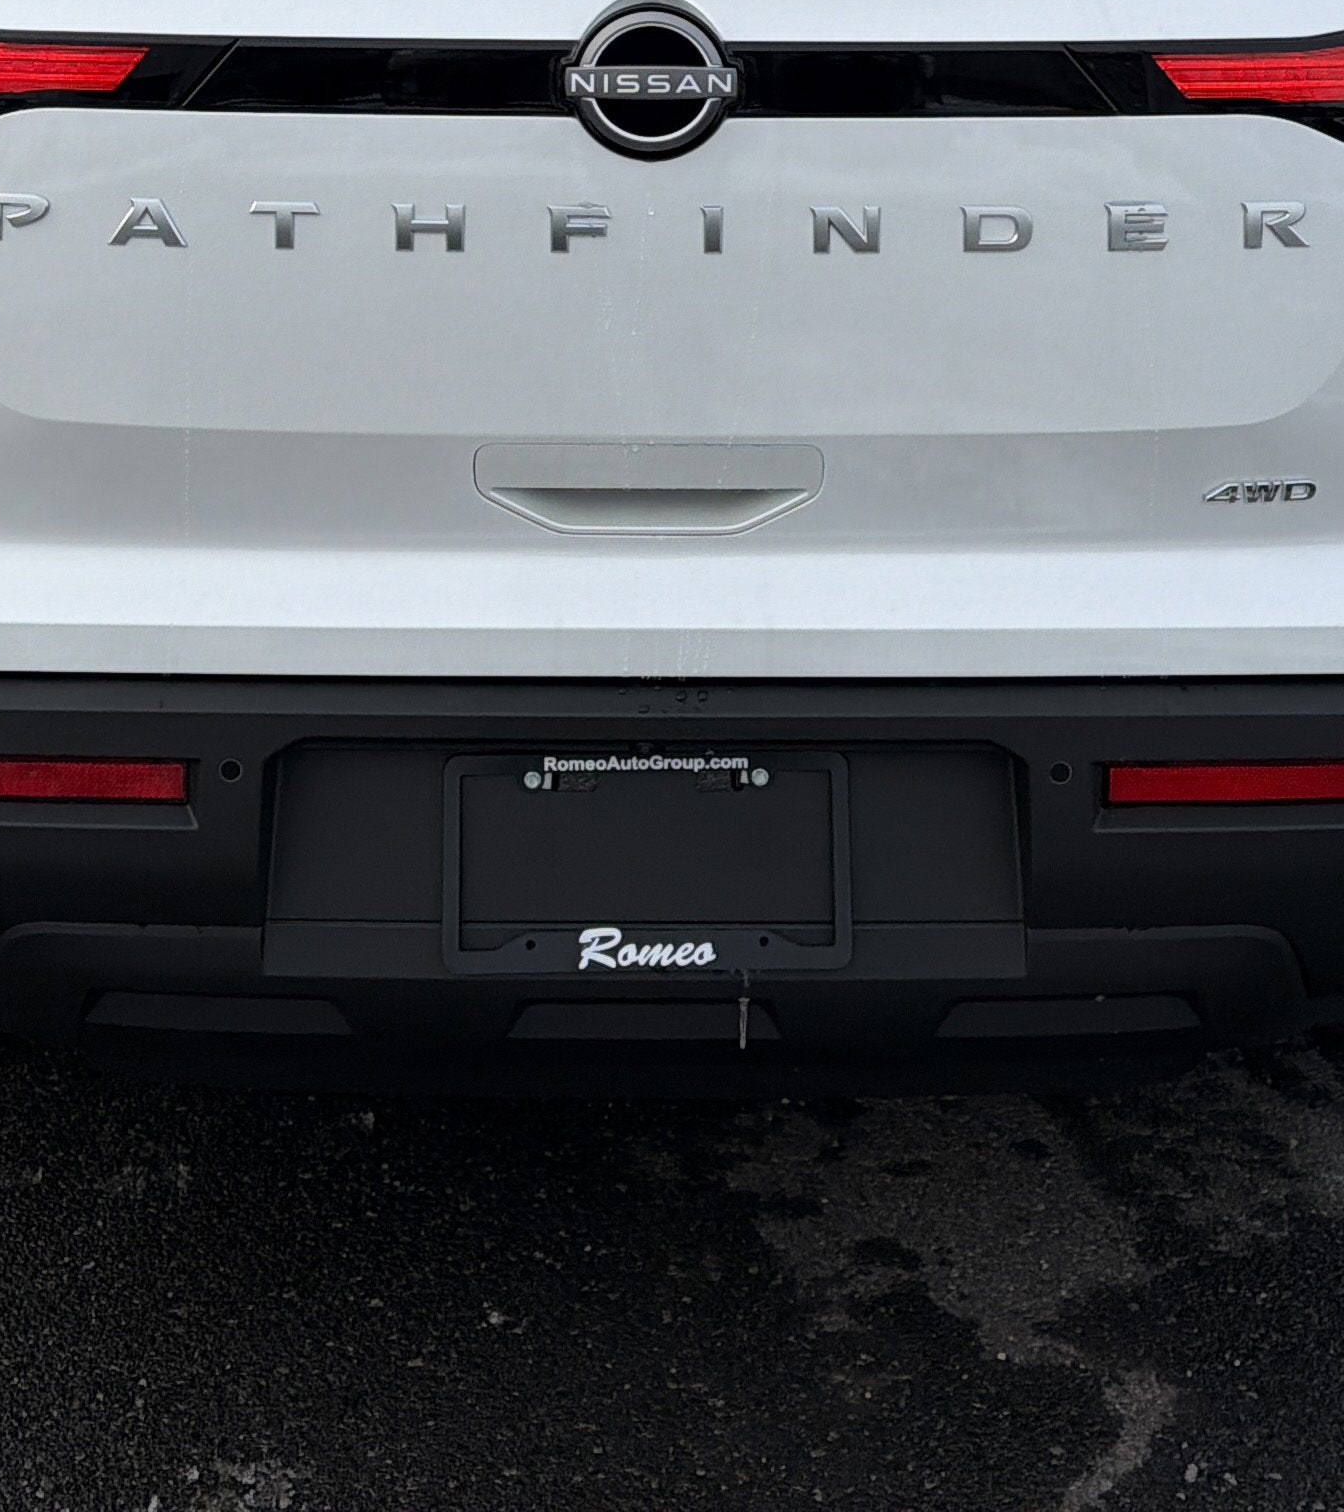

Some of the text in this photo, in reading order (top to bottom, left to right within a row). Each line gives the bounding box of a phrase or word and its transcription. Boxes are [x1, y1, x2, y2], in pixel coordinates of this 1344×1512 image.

[570, 72, 732, 94] NISSAN
[1204, 479, 1317, 504] 4WD
[543, 754, 749, 773] RomeoAutoGroup.com
[578, 926, 717, 970] Romeo
